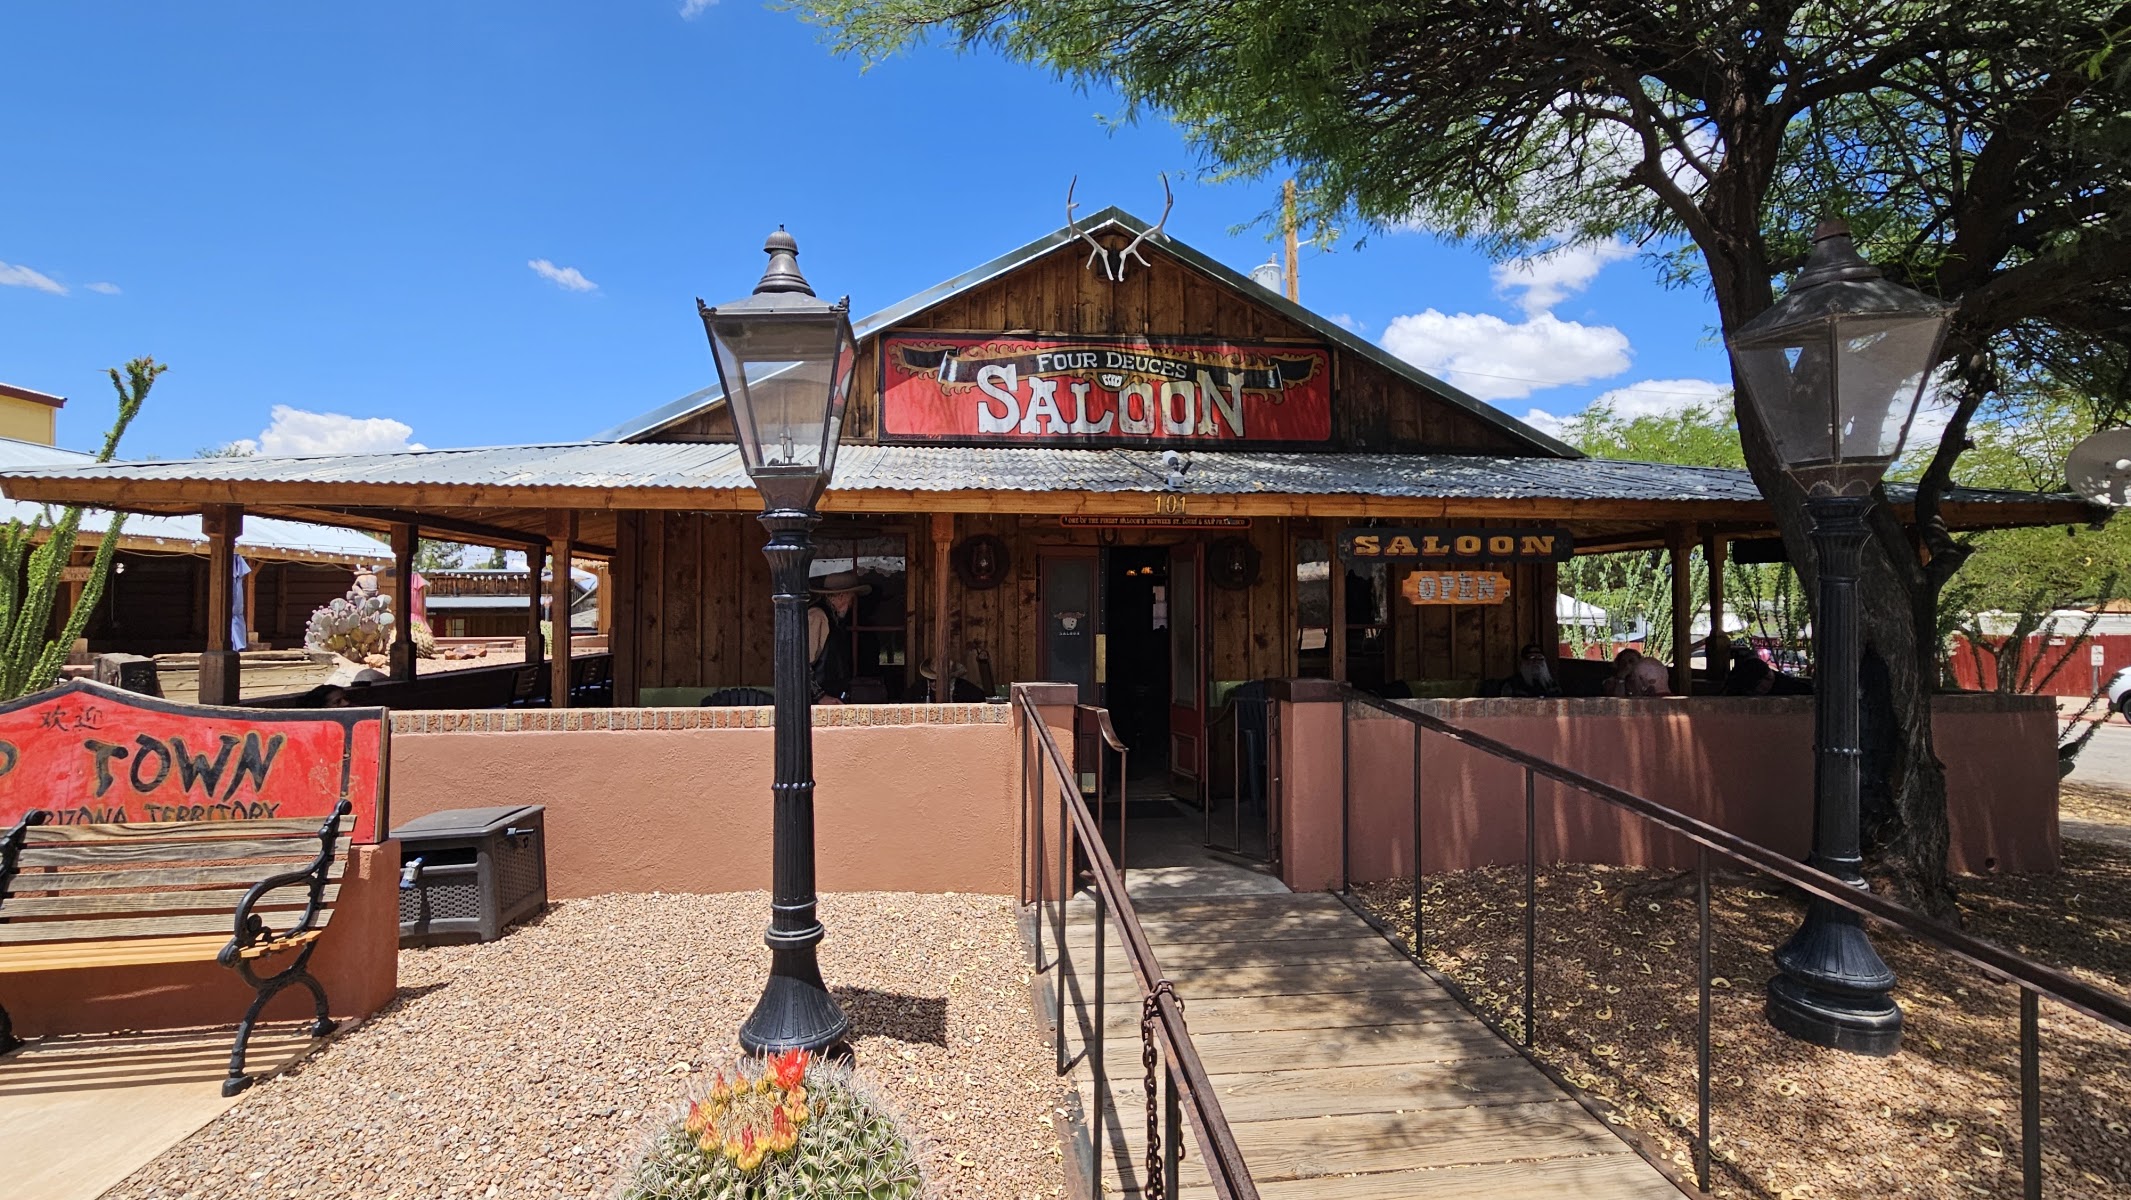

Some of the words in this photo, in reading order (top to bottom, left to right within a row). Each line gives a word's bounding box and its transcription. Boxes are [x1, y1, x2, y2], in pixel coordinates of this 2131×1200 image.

[1036, 352, 1098, 373] FOUR
[1106, 351, 1188, 379] DEUCES
[976, 363, 1246, 437] SALOON
[1154, 494, 1187, 514] 101
[1099, 517, 1119, 525] FINEST
[1182, 517, 1198, 525] LOUIS
[1353, 535, 1555, 557] SALOON
[1418, 575, 1496, 600] OPEN
[39, 704, 104, 732] 欢迎
[84, 732, 285, 801] TOWN
[43, 805, 128, 825] RIZONA
[144, 801, 281, 823] TERRITORY
